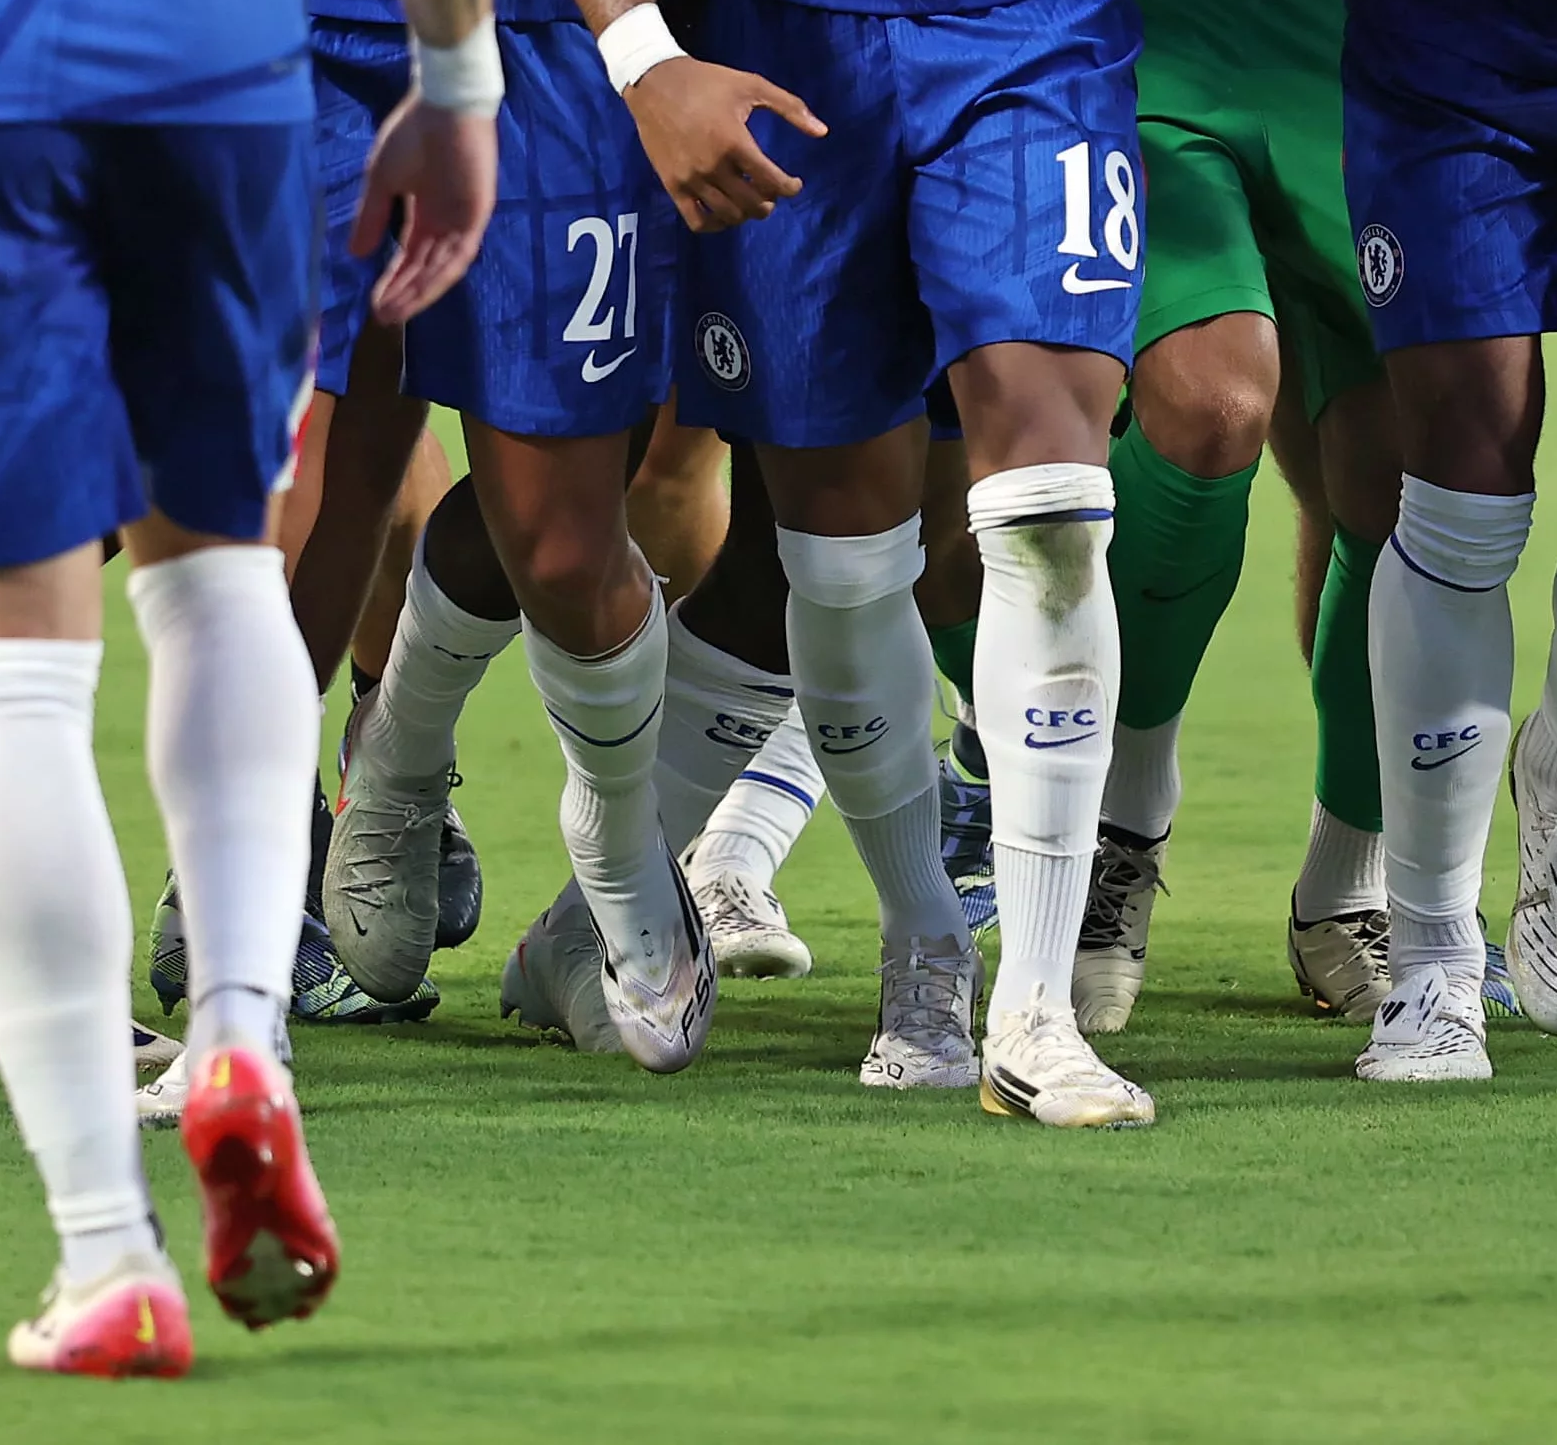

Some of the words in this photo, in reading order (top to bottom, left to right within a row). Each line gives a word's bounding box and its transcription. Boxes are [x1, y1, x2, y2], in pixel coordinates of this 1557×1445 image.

[1056, 141, 1140, 271] 18
[562, 212, 639, 342] 27
[715, 713, 773, 742] CFC
[818, 716, 888, 739] CFC
[1025, 707, 1097, 728] CFC
[1413, 724, 1481, 751] CFC
